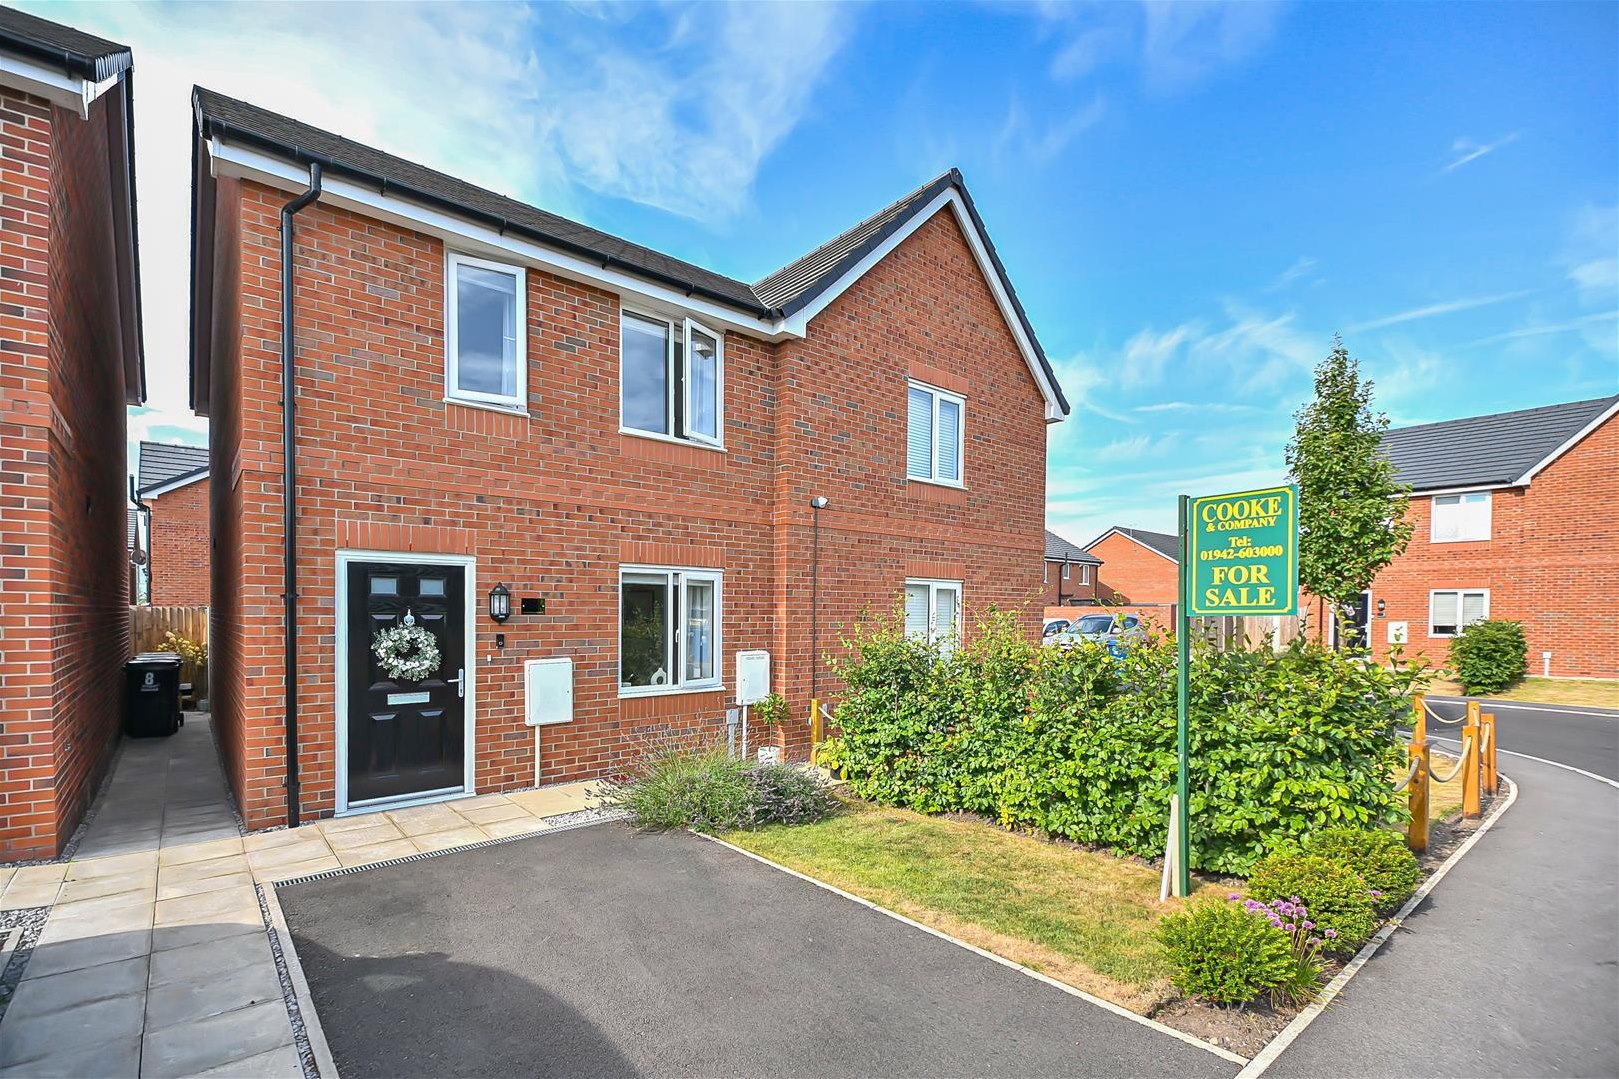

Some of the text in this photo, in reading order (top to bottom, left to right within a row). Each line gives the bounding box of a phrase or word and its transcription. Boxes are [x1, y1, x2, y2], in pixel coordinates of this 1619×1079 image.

[1202, 496, 1282, 522] COOKE
[1205, 516, 1277, 533] & COMPANY
[1228, 536, 1252, 548] Tel:
[1200, 545, 1284, 561] 01942-603000
[1211, 565, 1271, 585] FOR
[1205, 587, 1276, 607] SALE
[145, 672, 154, 685] 8
